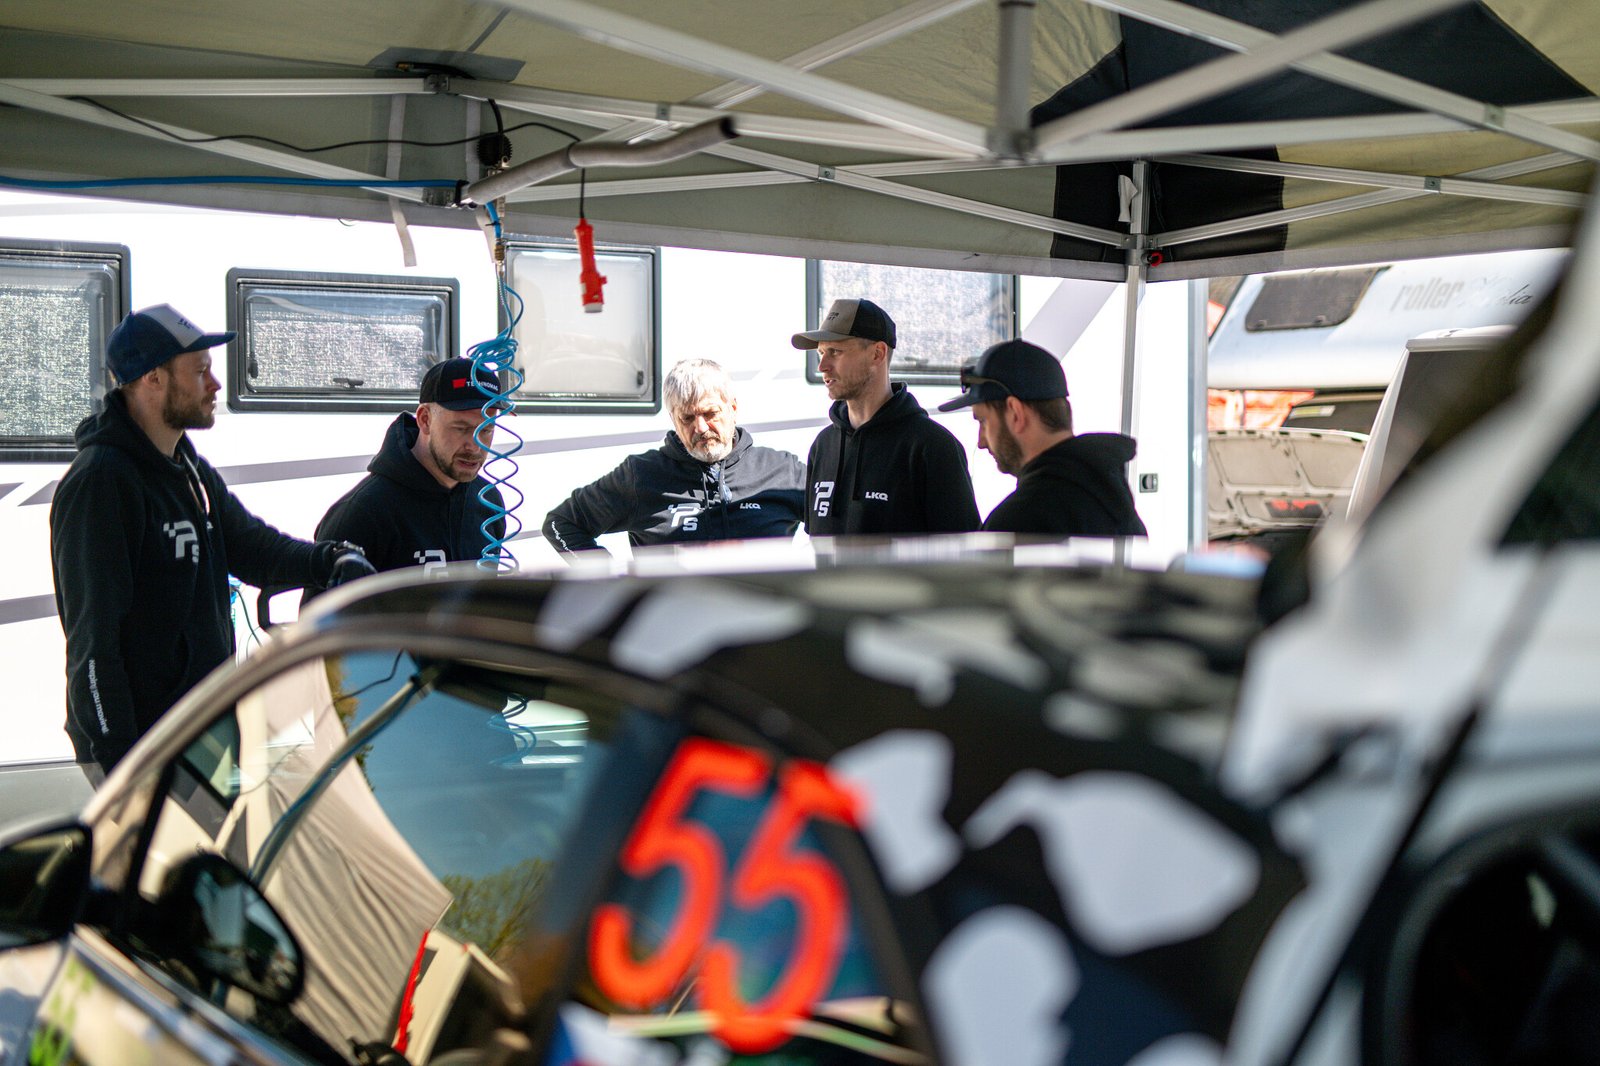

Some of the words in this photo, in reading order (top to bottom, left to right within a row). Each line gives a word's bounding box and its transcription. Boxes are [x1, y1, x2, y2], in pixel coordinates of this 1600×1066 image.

[1390, 278, 1464, 312] roller
[740, 502, 762, 510] LKQ
[865, 491, 889, 502] LKQ
[588, 735, 872, 1055] 55
